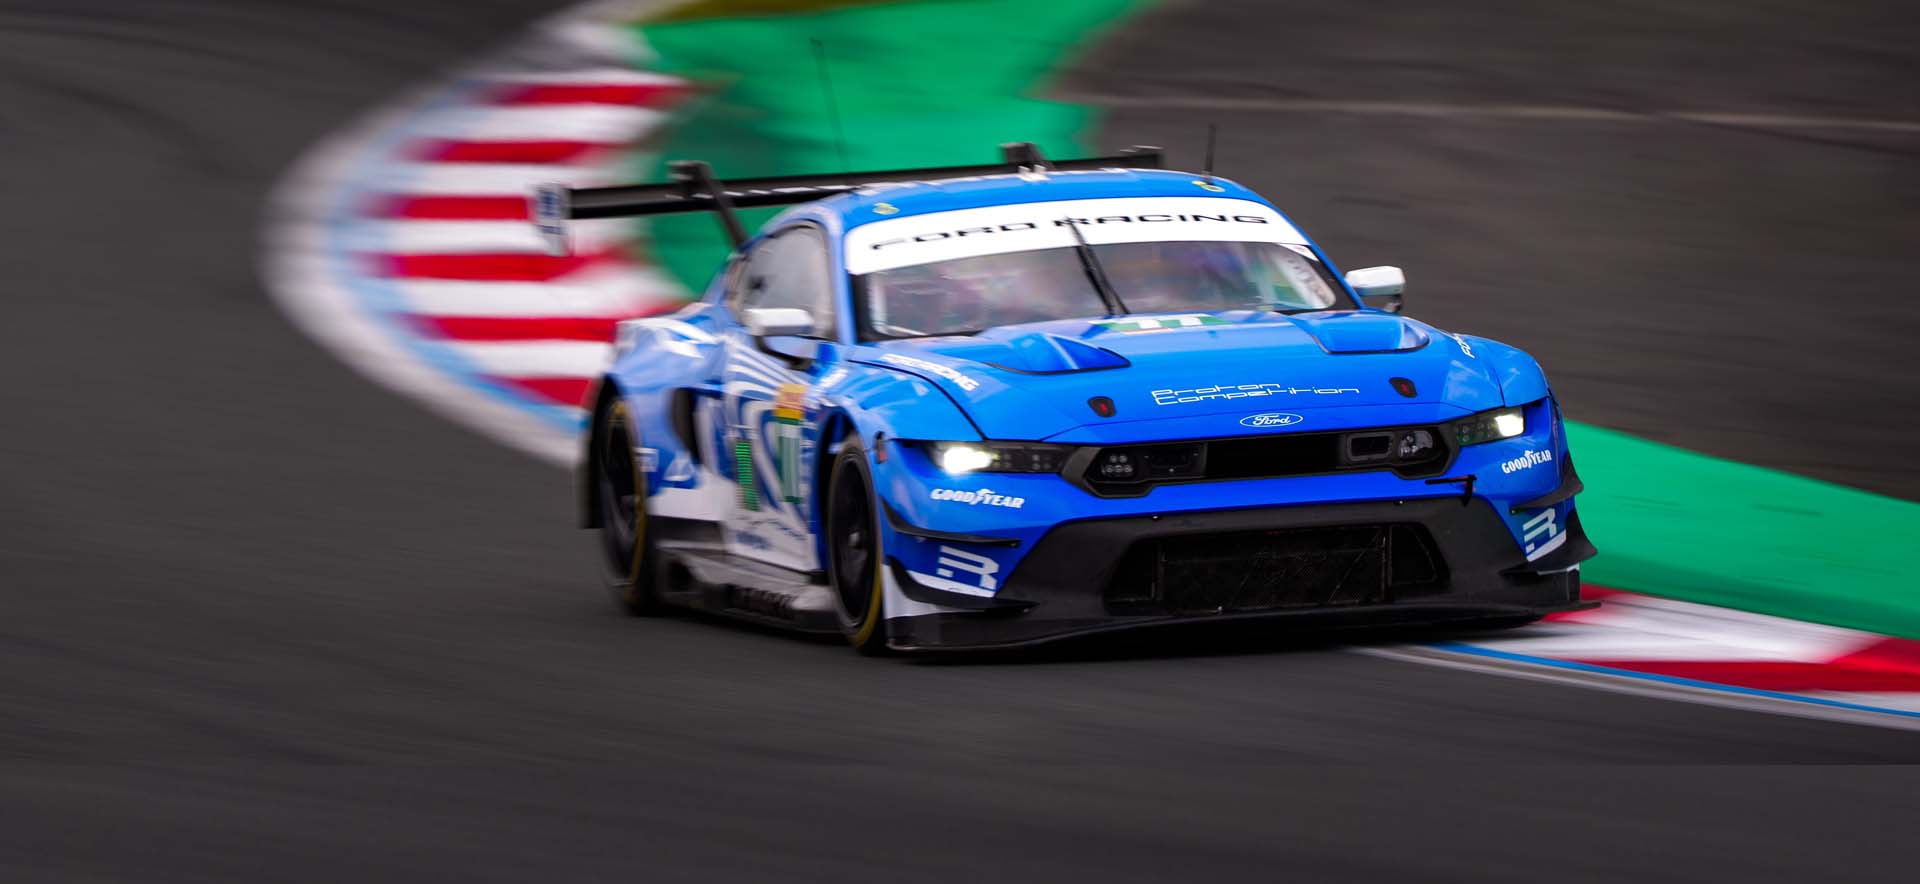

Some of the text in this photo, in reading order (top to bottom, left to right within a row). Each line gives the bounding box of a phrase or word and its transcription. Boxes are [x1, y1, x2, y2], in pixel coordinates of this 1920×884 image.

[871, 214, 1268, 250] FORD RACING
[1151, 383, 1281, 398] Proton
[1155, 386, 1360, 406] Competition
[1252, 413, 1292, 426] Ford
[1501, 449, 1552, 474] GOODYEAR
[930, 488, 1025, 508] GOODYEAR
